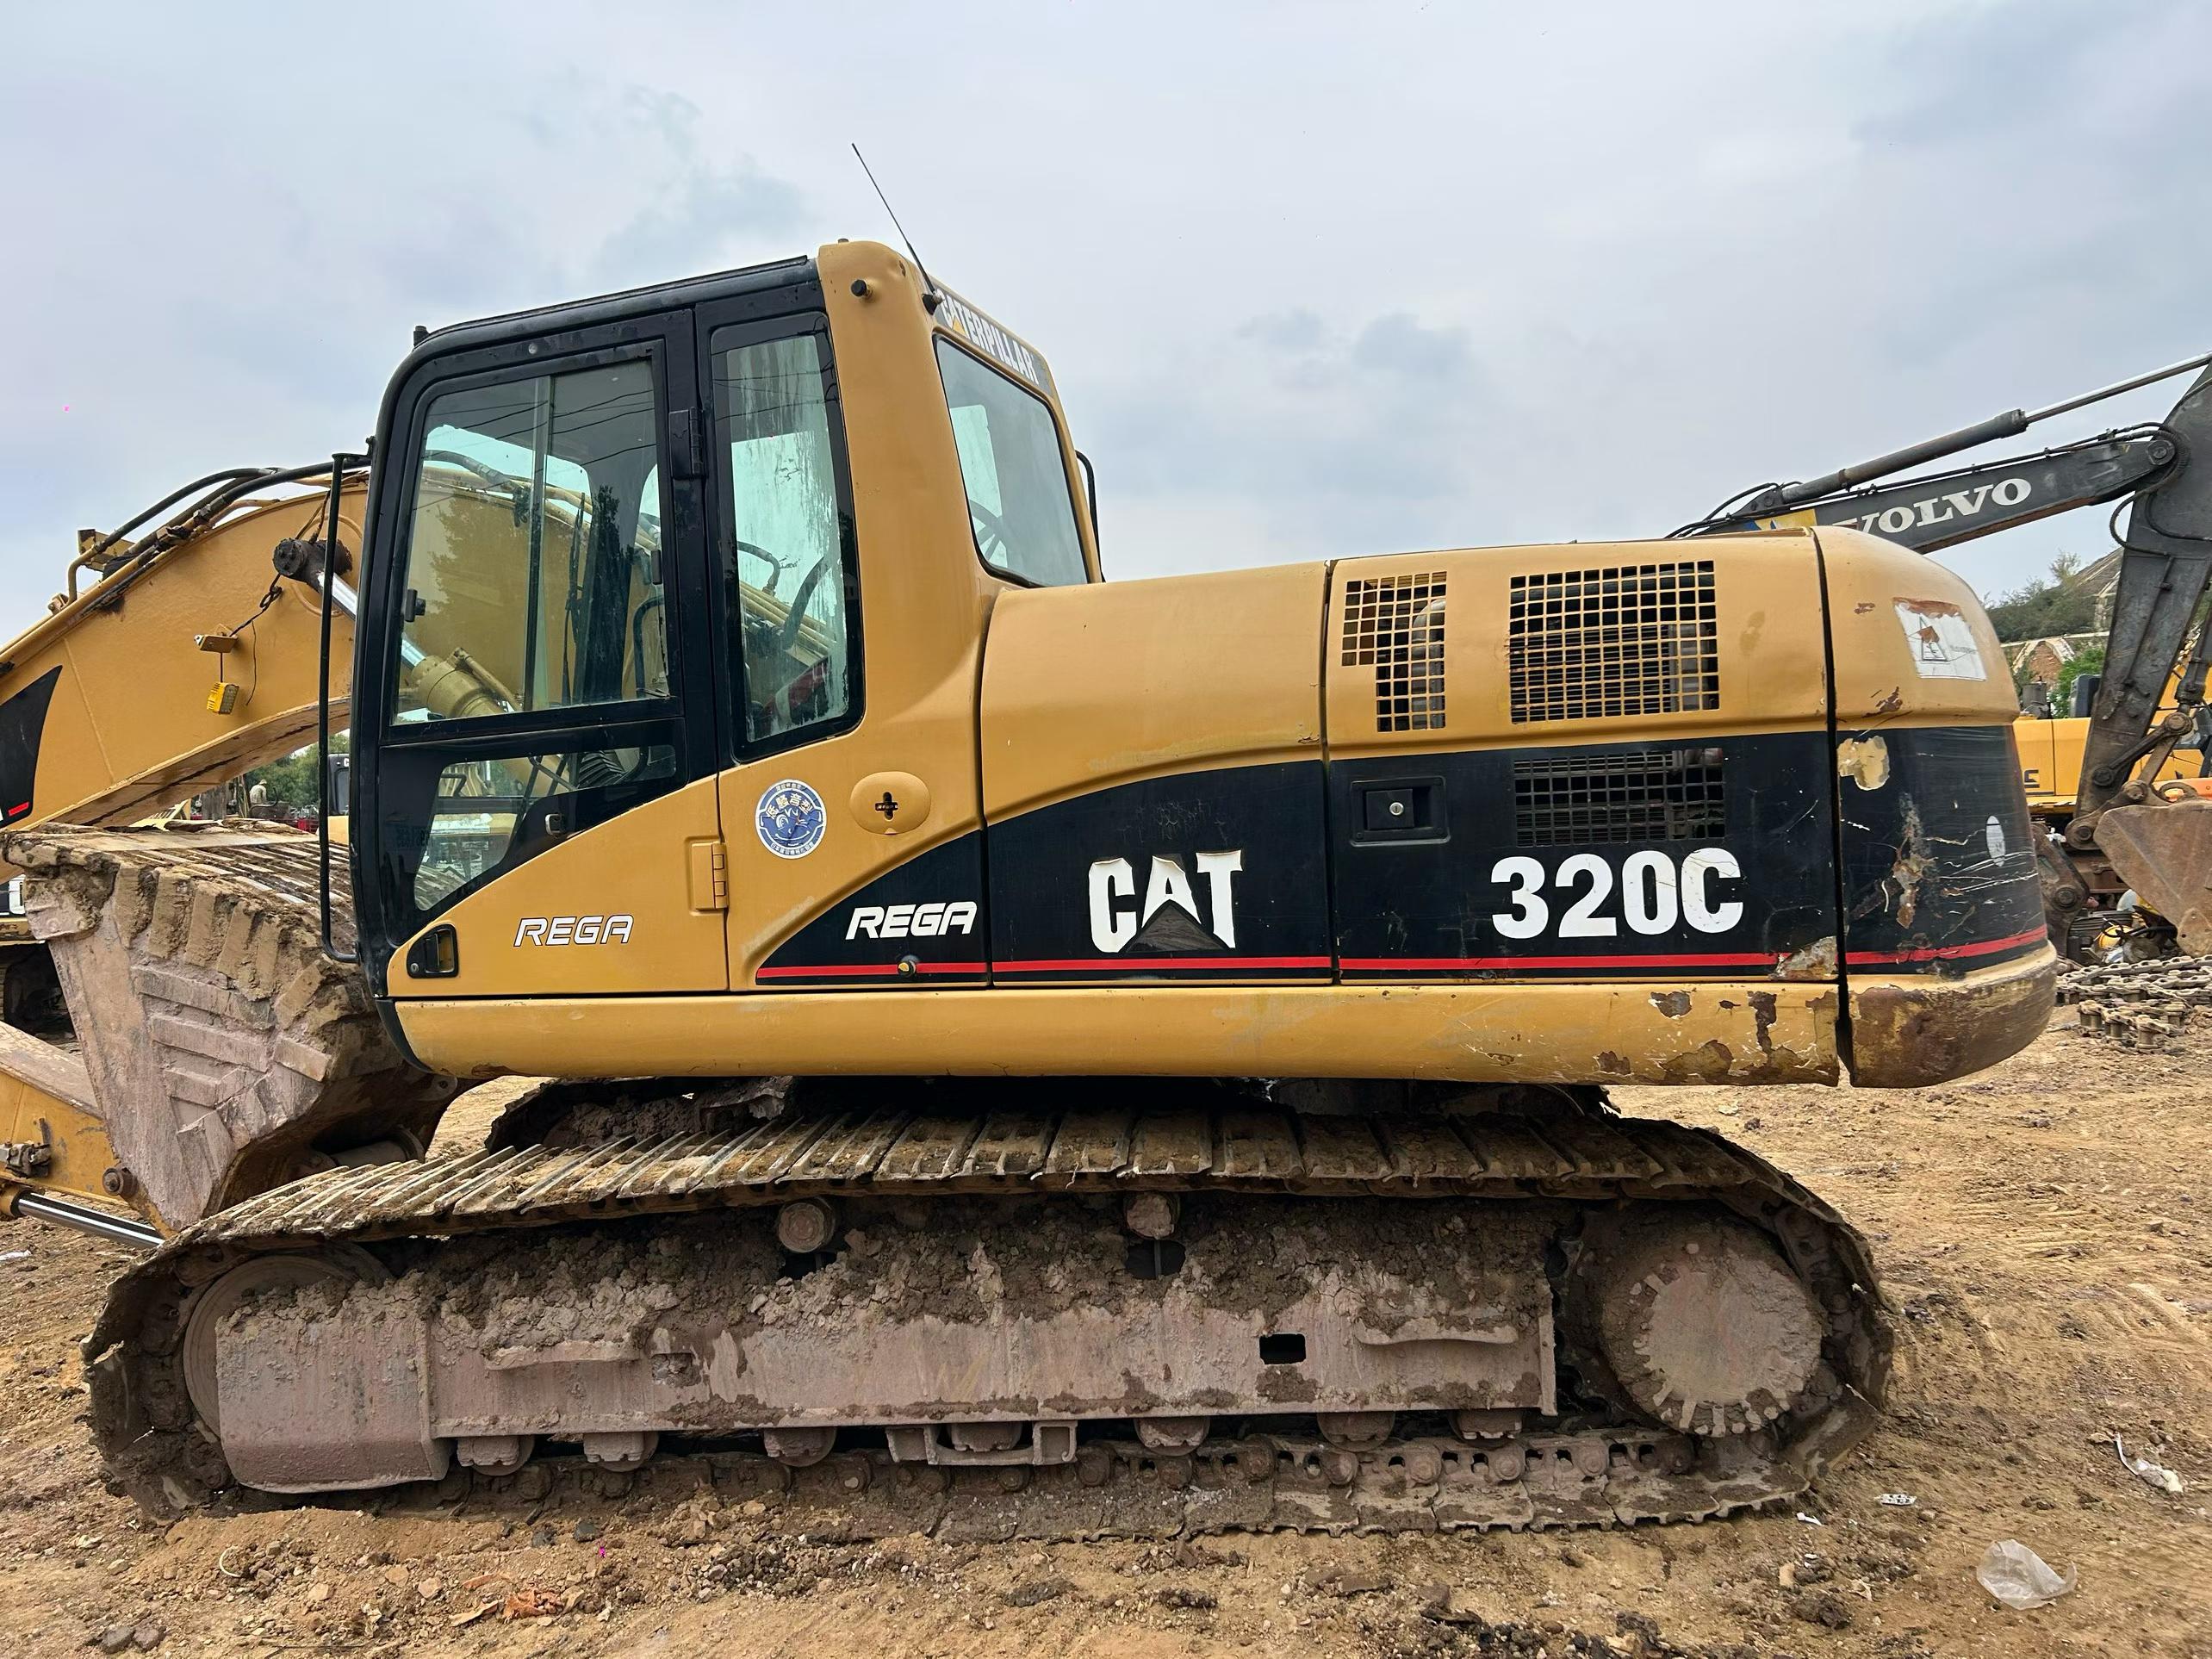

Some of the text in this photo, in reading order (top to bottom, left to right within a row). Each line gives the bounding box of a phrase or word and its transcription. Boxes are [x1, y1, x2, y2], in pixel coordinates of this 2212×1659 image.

[935, 288, 1039, 385] CATERPILLAR
[513, 915, 634, 947] REGA
[845, 901, 977, 940] REGA
[1088, 849, 1243, 953] CAT
[1490, 848, 1743, 939] 320C
